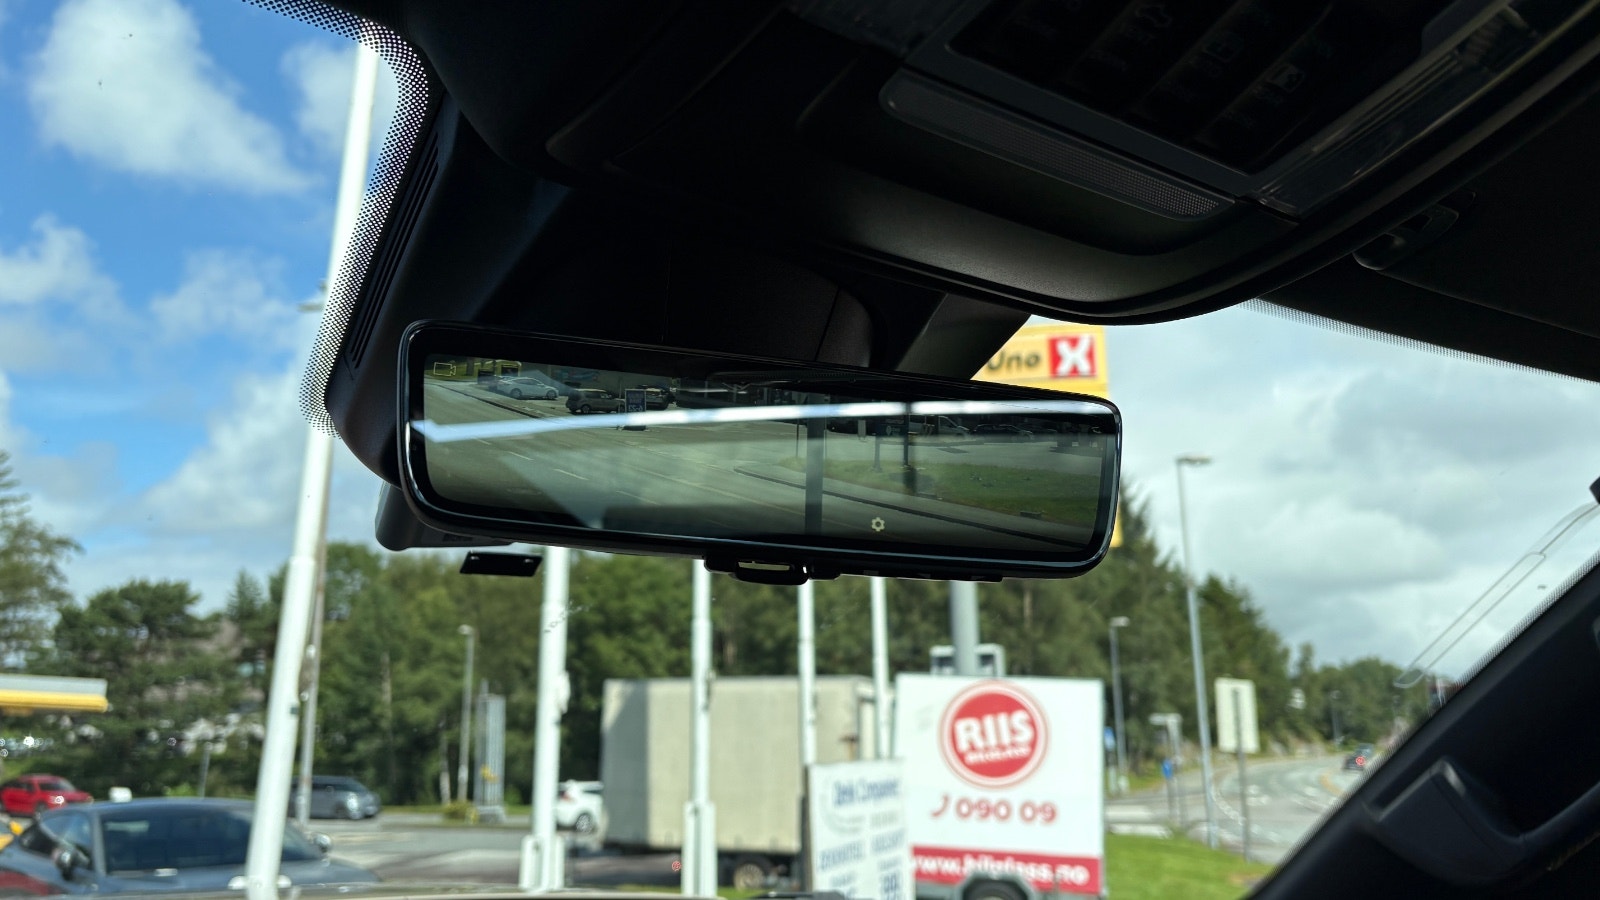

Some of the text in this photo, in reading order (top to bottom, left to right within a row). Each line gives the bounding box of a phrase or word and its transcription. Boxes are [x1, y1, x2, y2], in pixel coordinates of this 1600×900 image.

[987, 334, 1092, 377] Uno X
[954, 709, 1035, 752] RIIS
[955, 798, 1057, 823] 090 09
